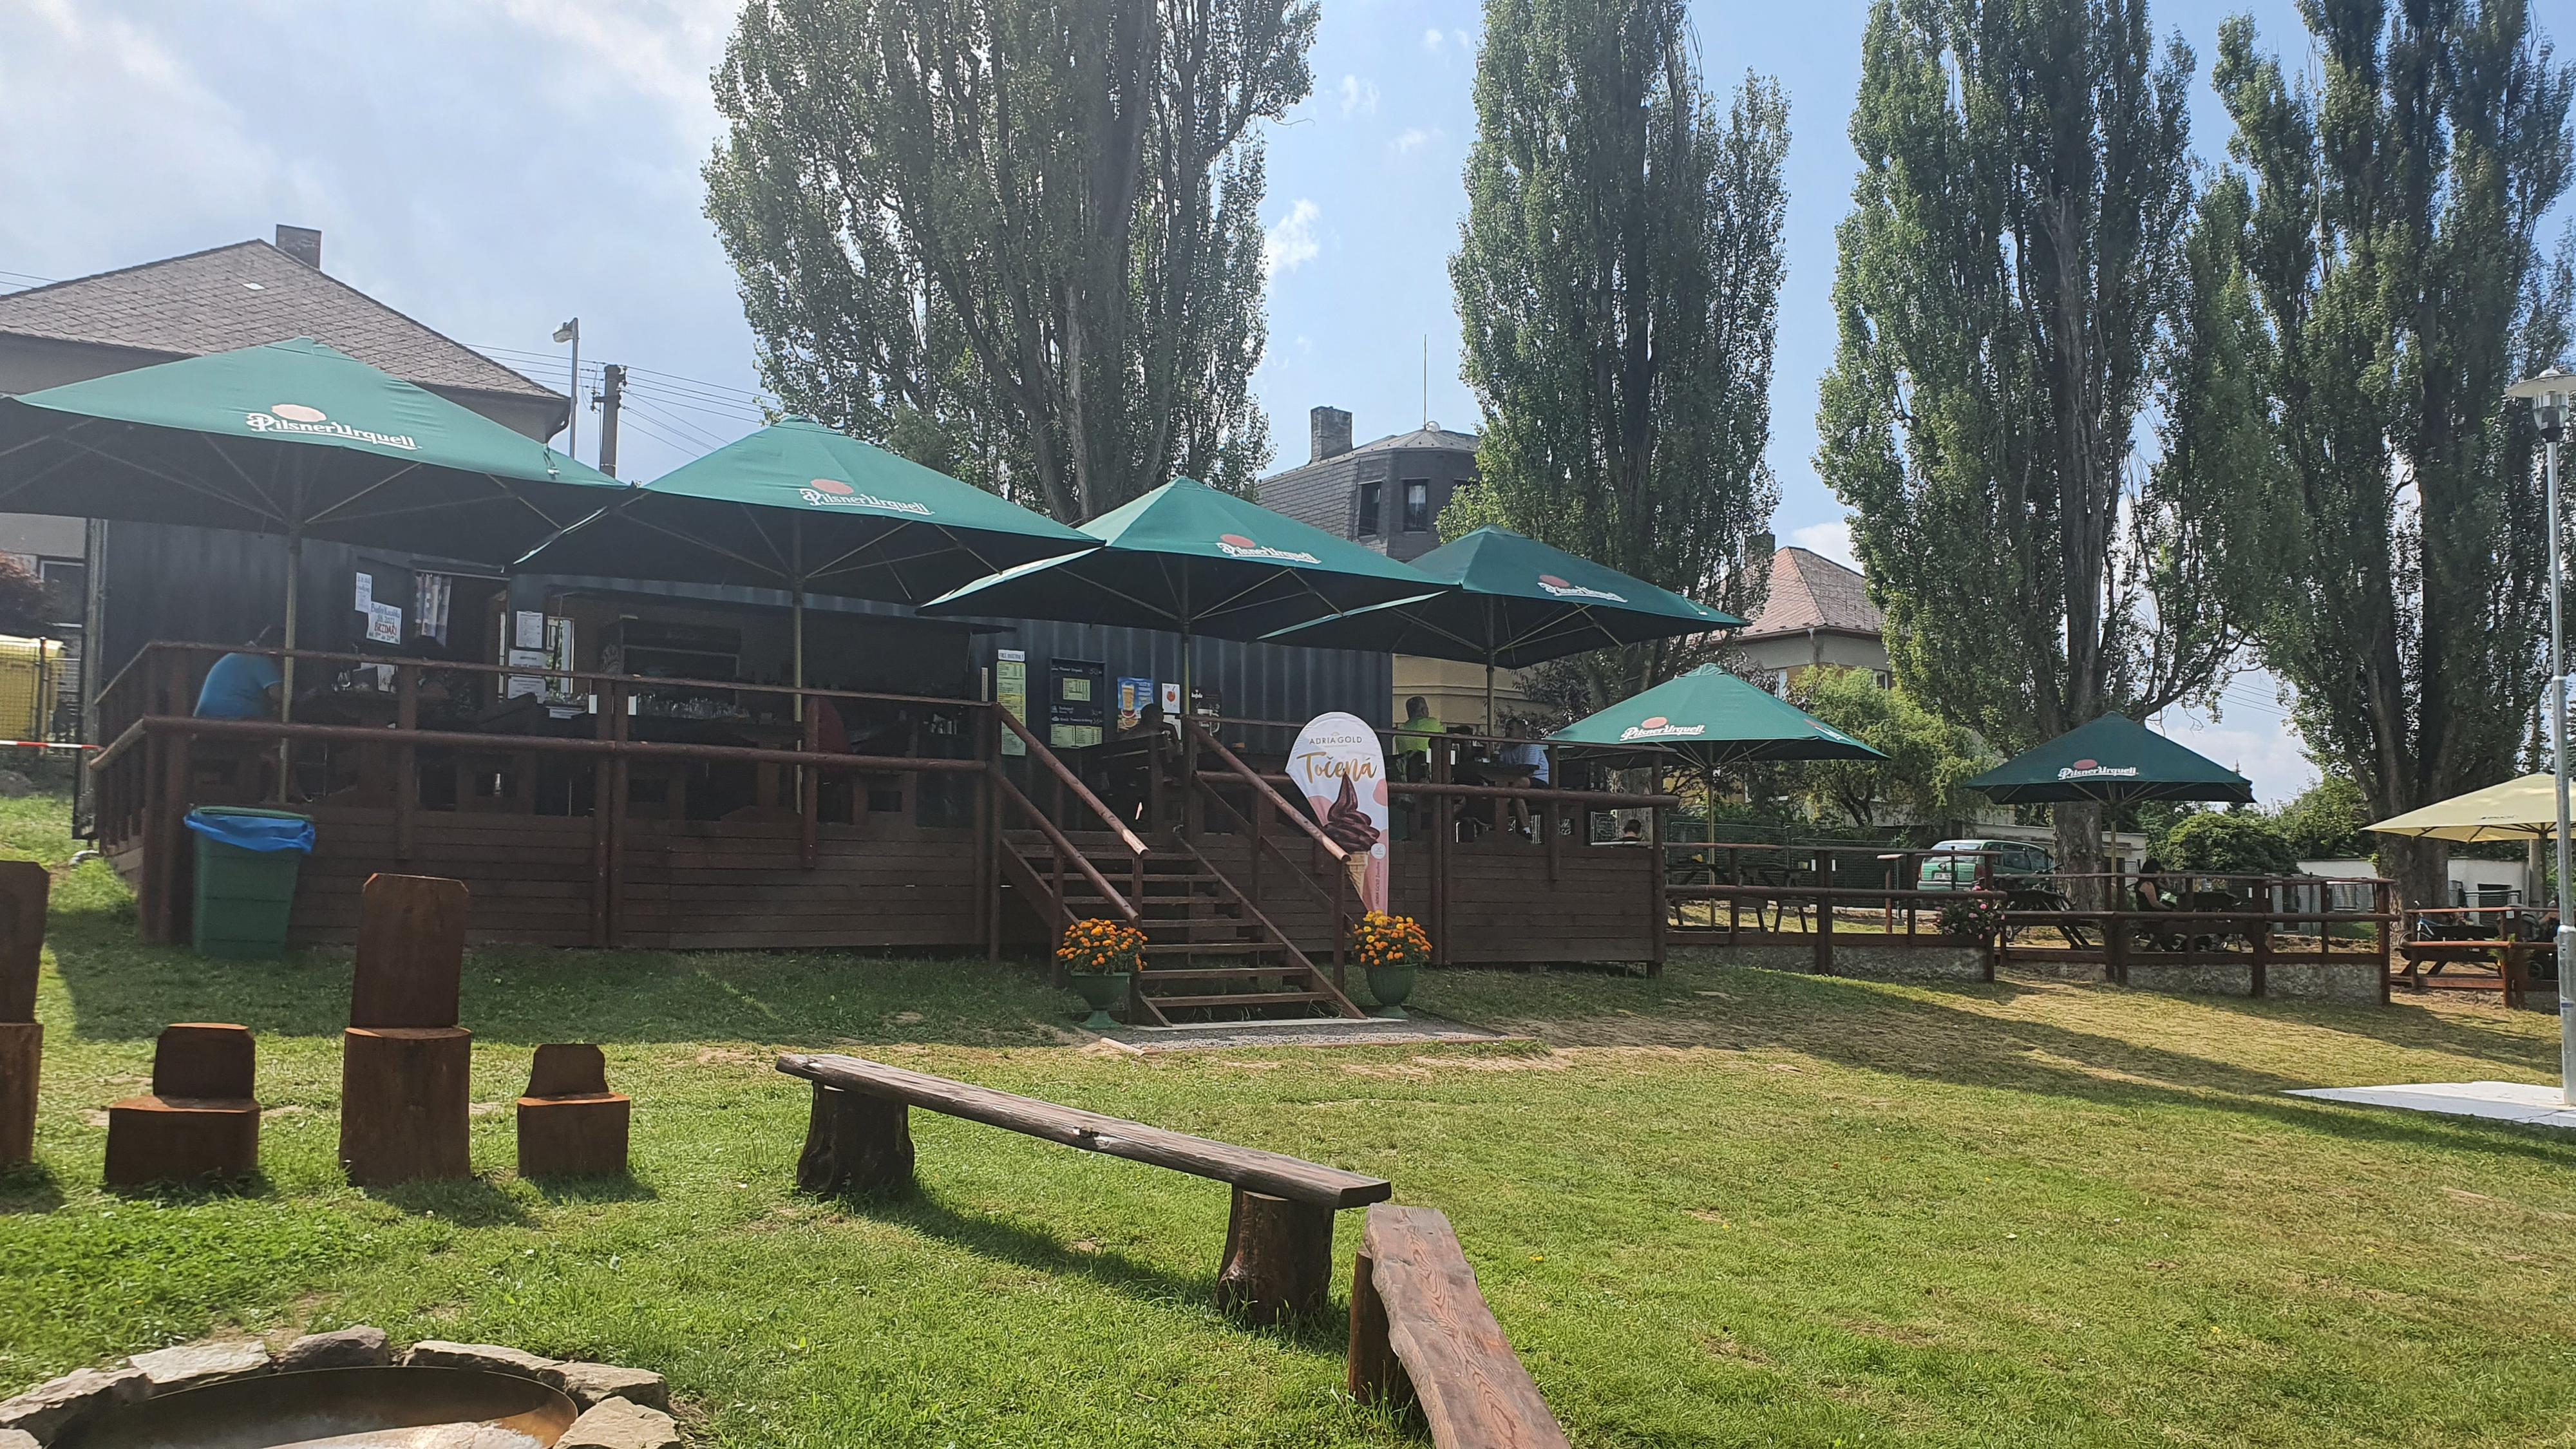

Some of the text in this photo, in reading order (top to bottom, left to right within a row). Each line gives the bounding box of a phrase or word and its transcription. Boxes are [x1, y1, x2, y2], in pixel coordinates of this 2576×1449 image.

[246, 413, 416, 448] Pilsner Urquell
[800, 488, 930, 513] Pilsner Urquell
[1620, 724, 1705, 741] Pilsner Urquell
[1296, 752, 1378, 784] Točená
[2058, 766, 2137, 780] Pilsner Urquell
